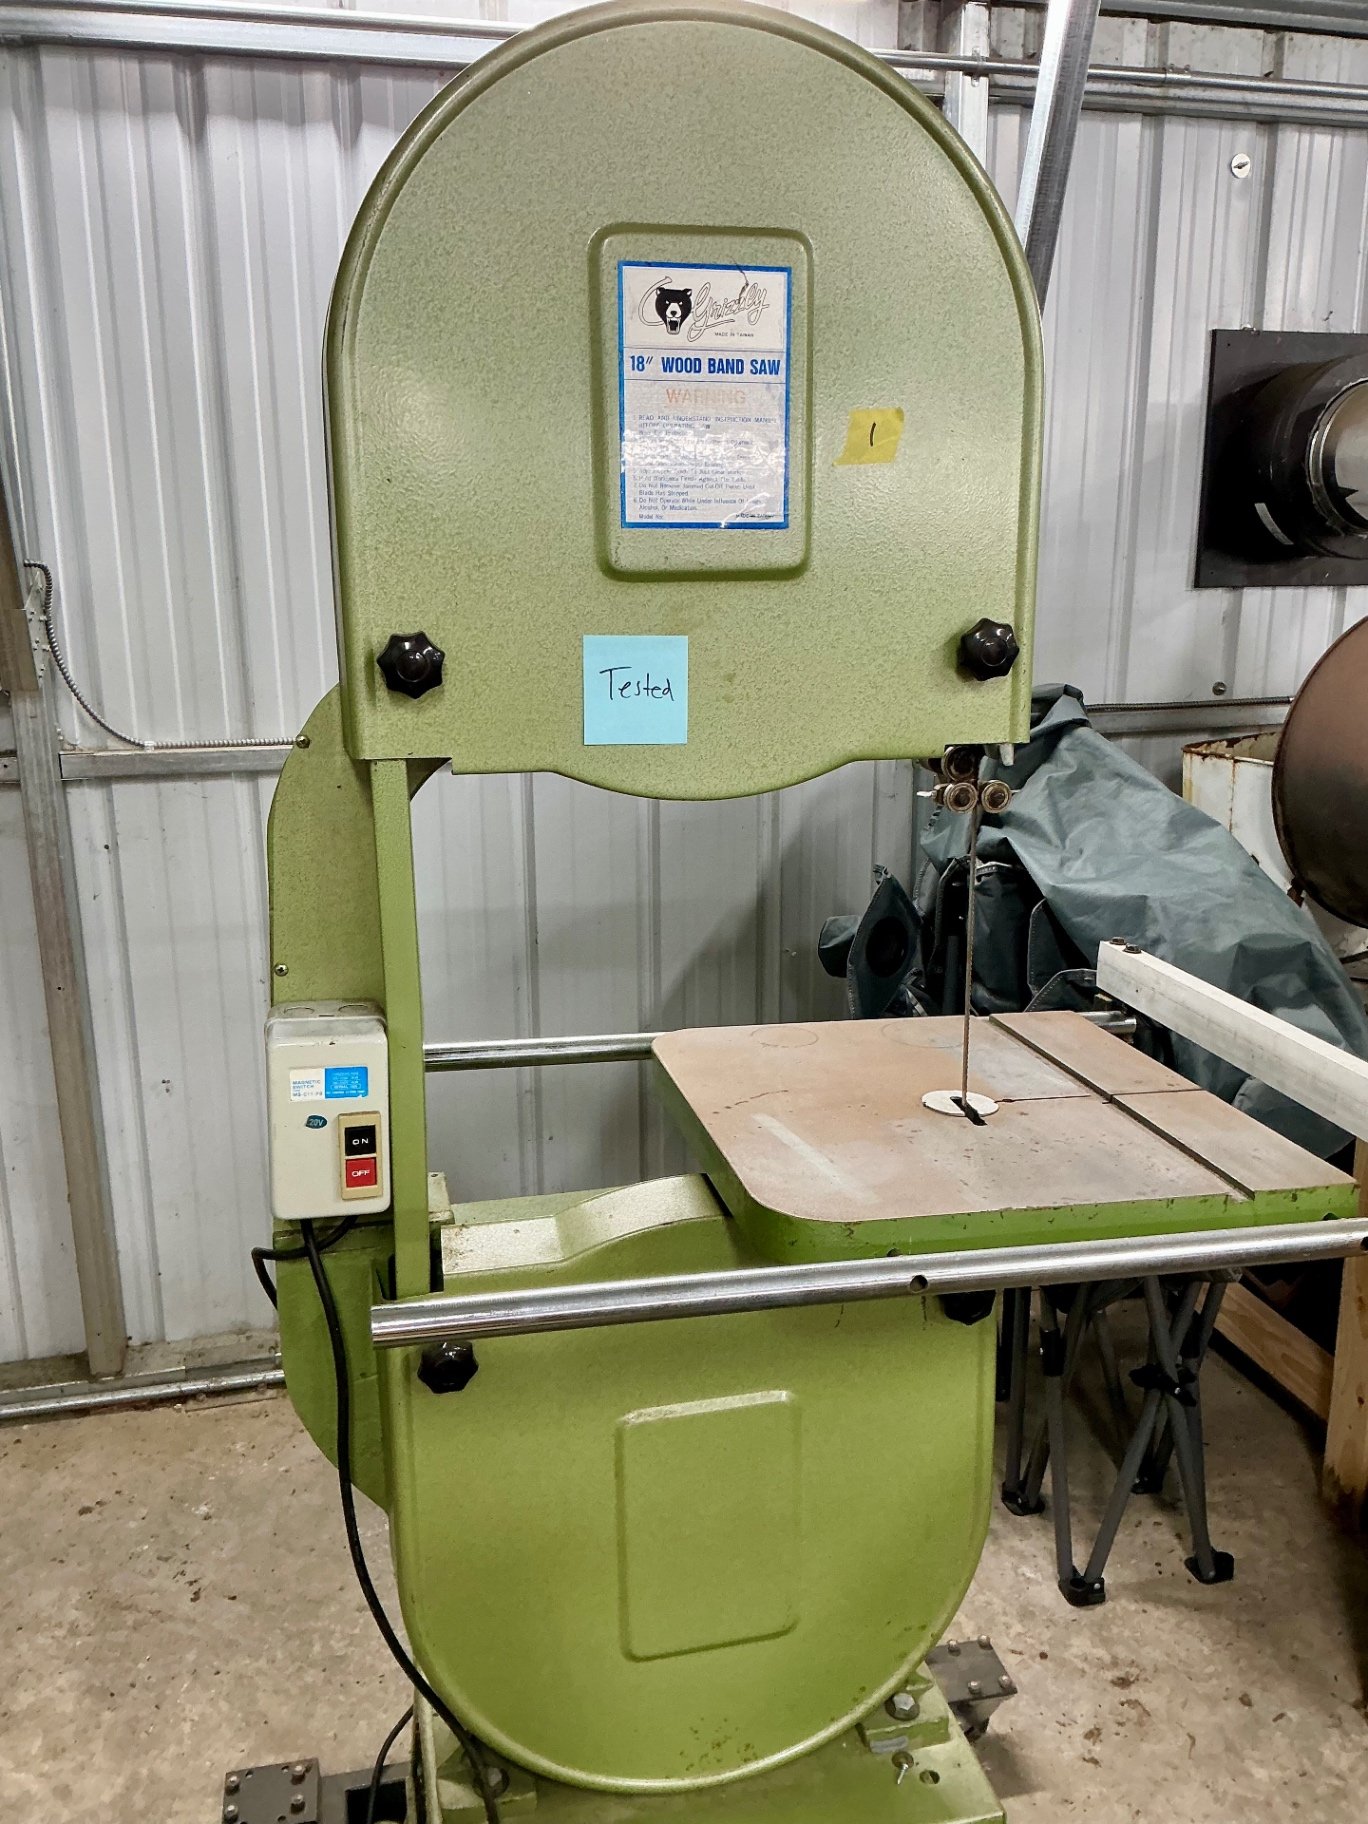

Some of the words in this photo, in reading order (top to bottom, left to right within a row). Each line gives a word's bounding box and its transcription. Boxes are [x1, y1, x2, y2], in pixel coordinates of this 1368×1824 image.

[661, 356, 702, 374] WOOD
[708, 357, 744, 375] BAND
[750, 359, 781, 376] SAW
[666, 388, 746, 405] WARNING
[599, 666, 674, 701] Tested
[352, 1138, 369, 1146] ON
[351, 1169, 370, 1177] OFF
